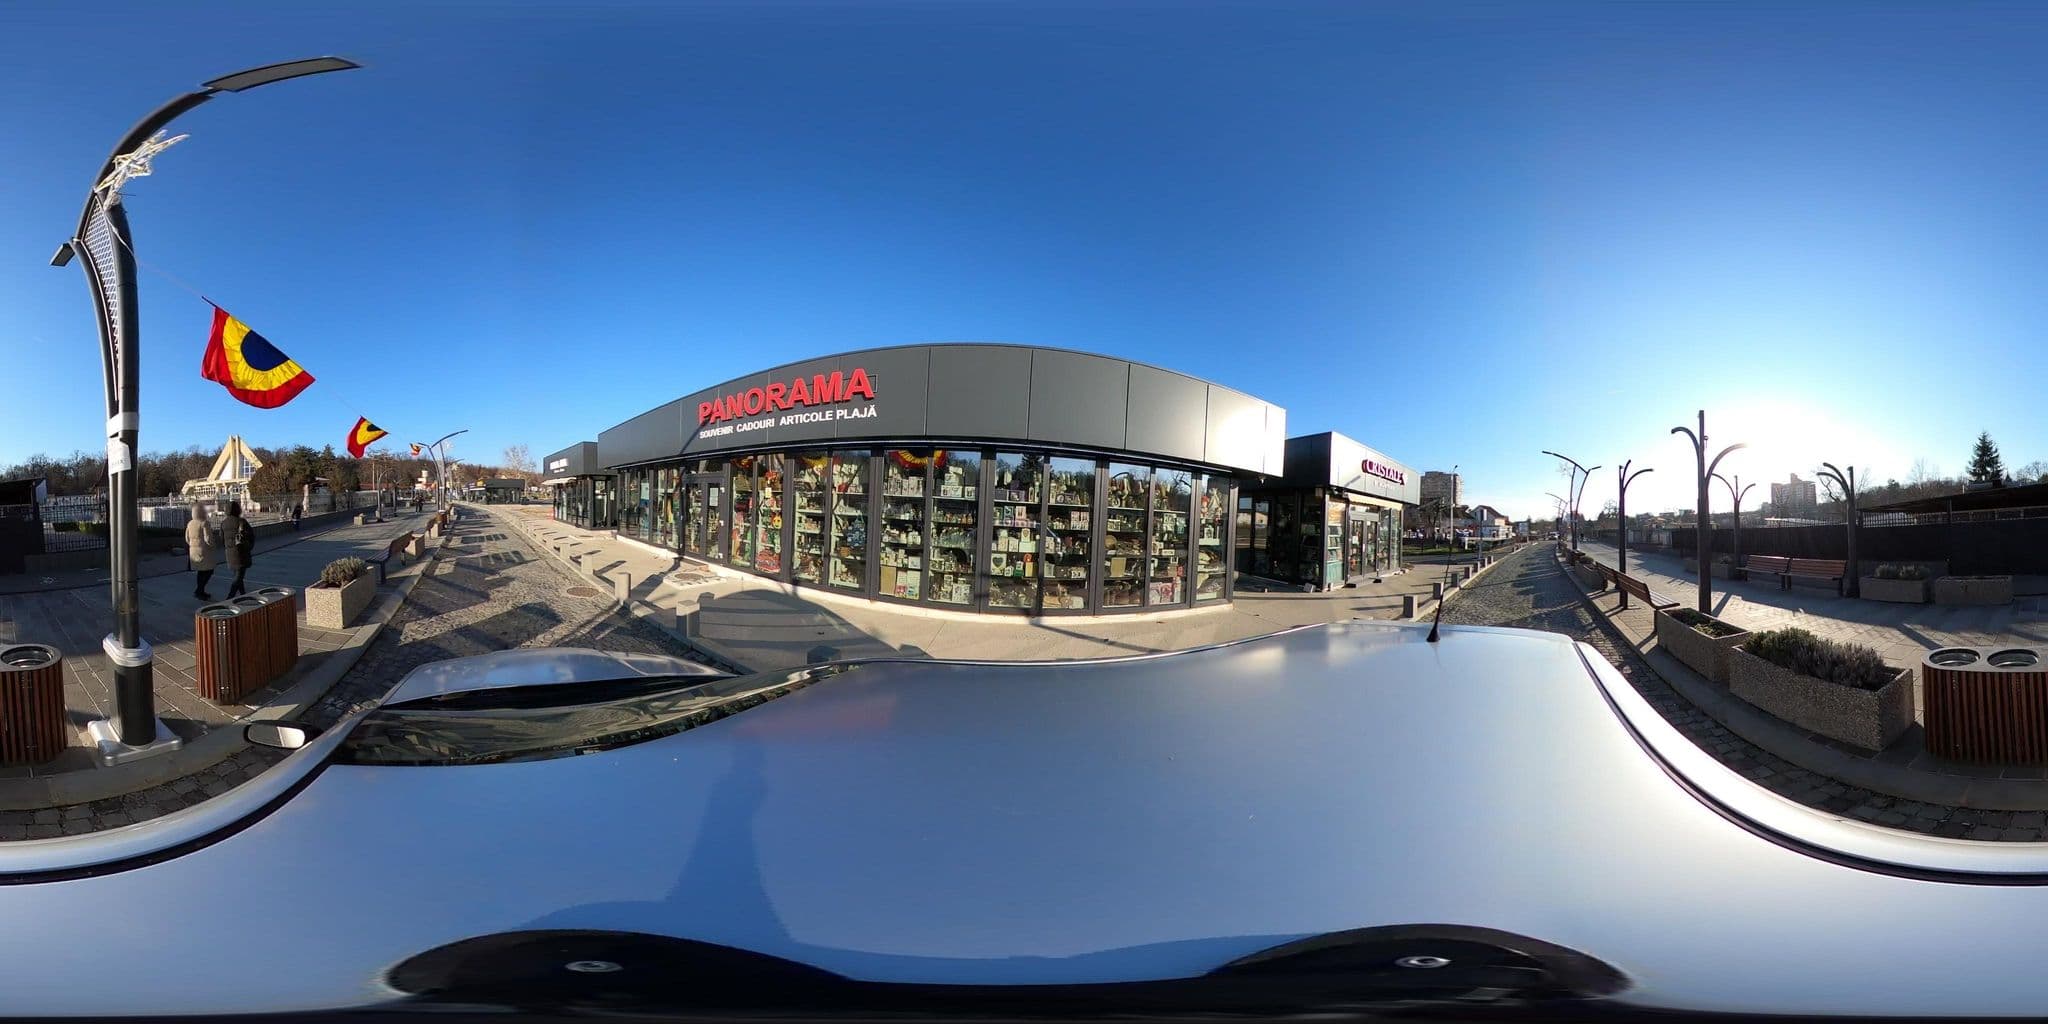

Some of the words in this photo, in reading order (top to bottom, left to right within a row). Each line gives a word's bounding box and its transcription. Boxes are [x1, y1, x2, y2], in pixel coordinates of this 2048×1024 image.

[698, 368, 875, 425] PANORAMA
[699, 426, 733, 439] SOUVENIR
[736, 418, 775, 433] CADOURI
[779, 410, 833, 426] ARTICOLE
[836, 405, 877, 420] PLAJĂ
